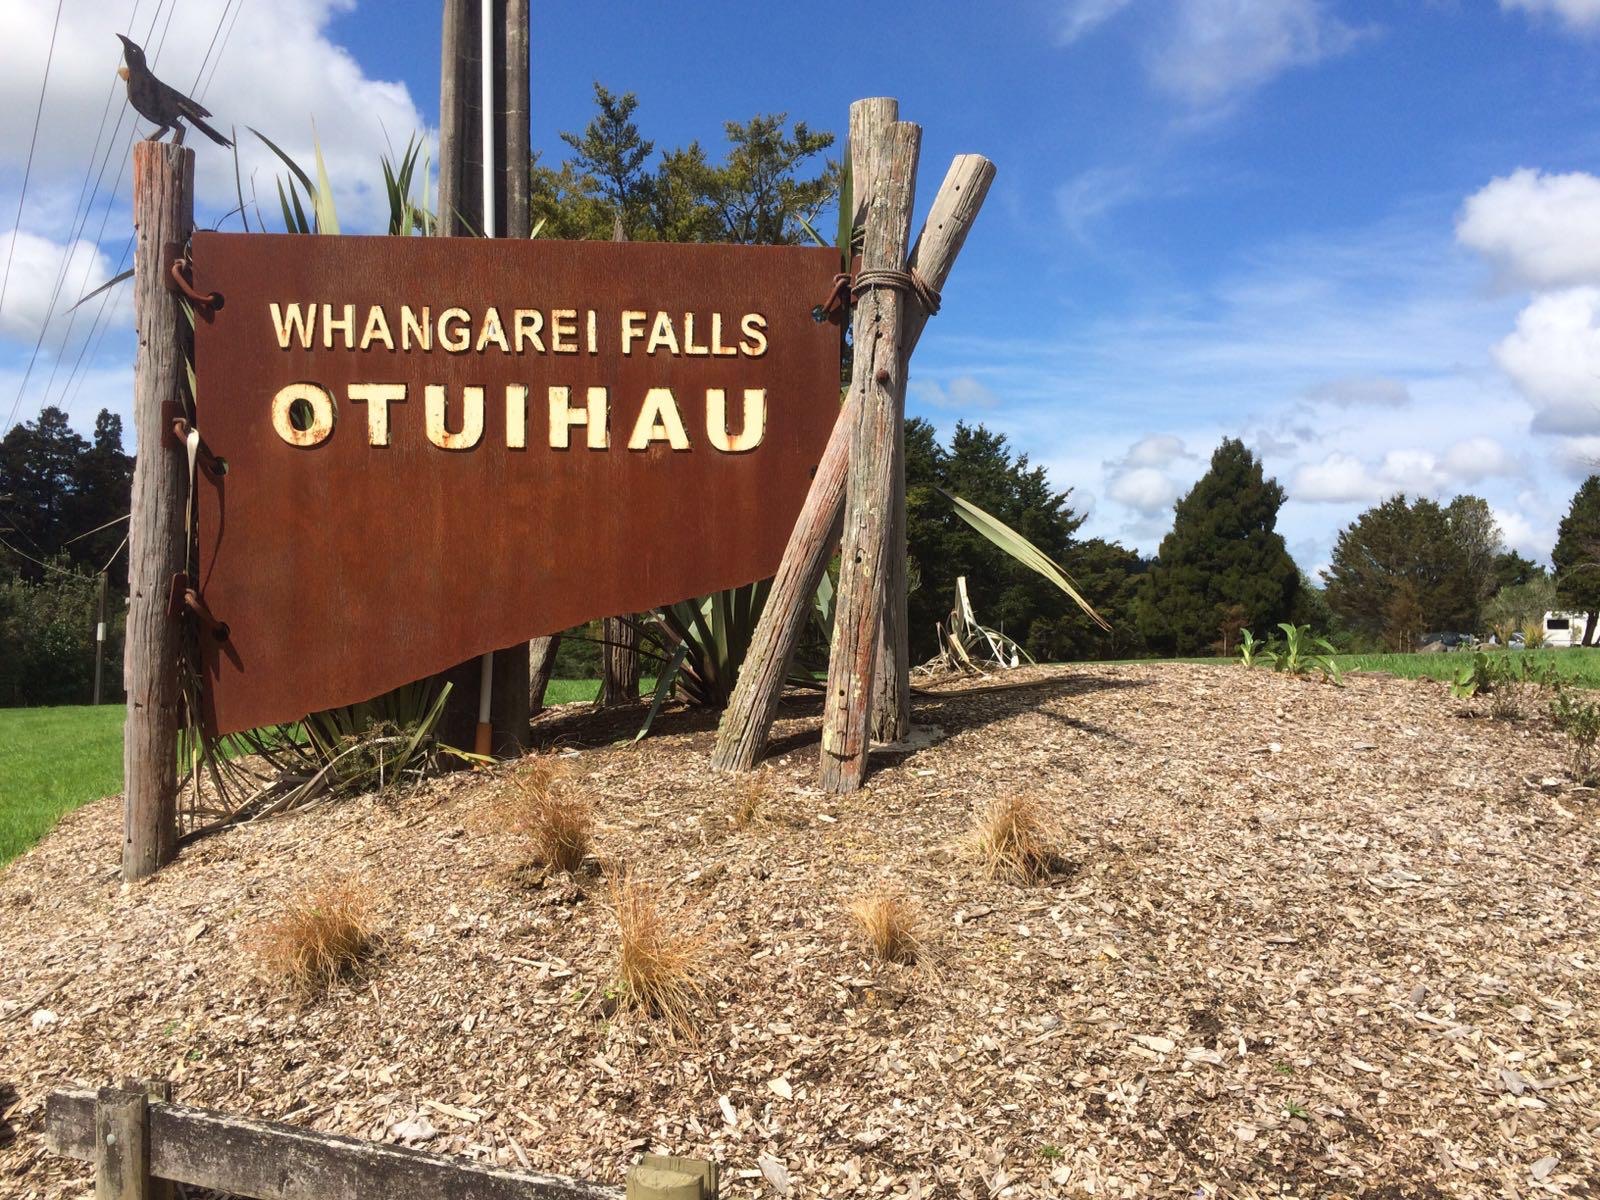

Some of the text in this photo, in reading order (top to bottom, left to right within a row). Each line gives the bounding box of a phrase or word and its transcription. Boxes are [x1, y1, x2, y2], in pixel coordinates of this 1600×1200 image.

[269, 302, 768, 357] WHANGAREI FALLS
[271, 382, 768, 452] OTUIHAU
